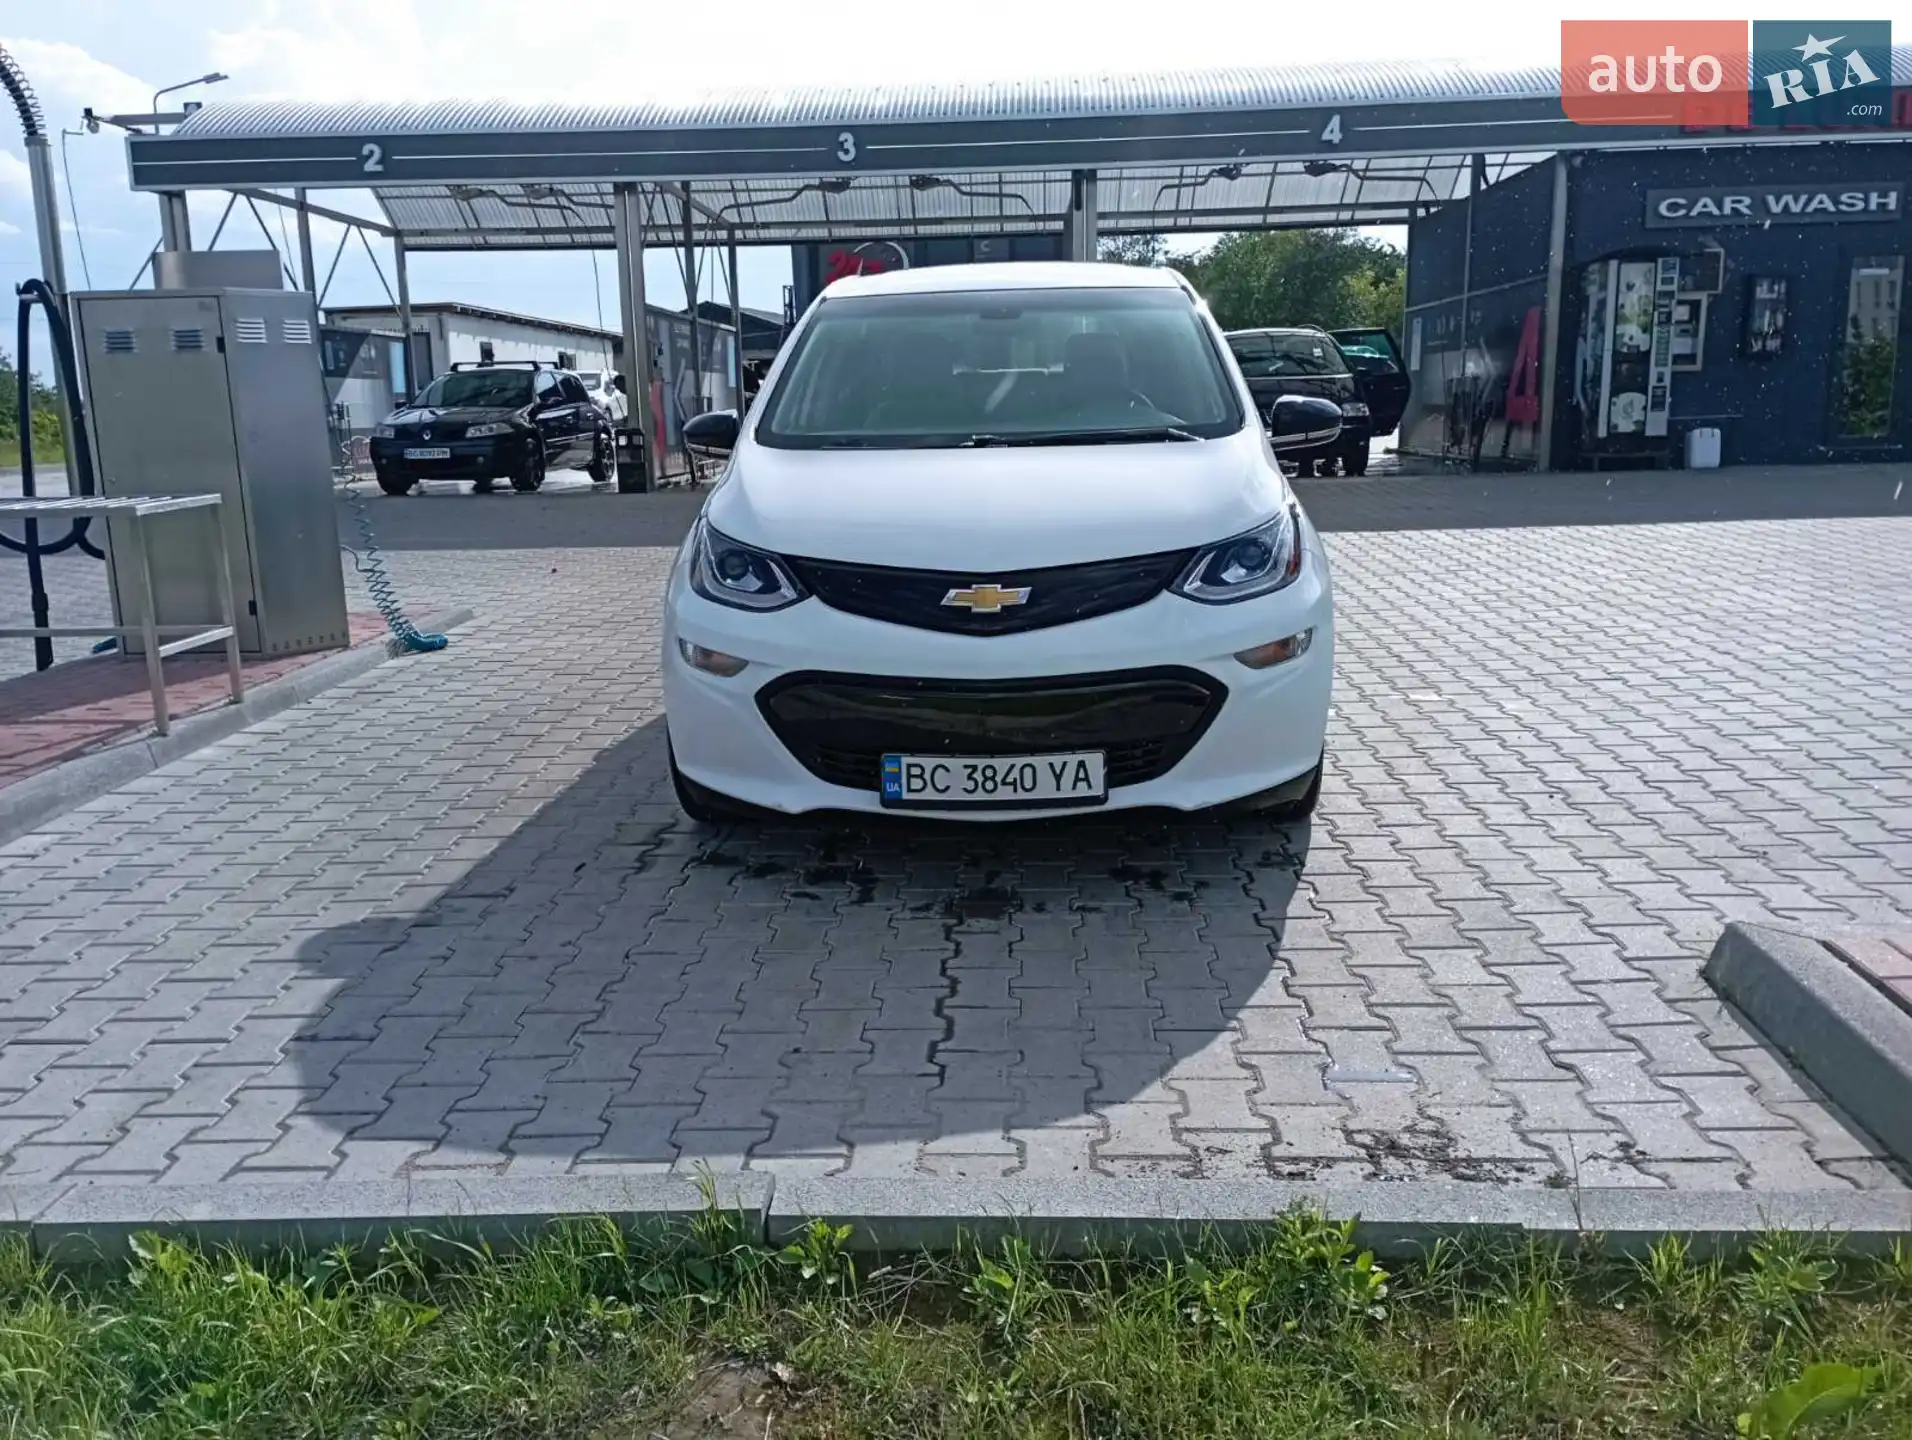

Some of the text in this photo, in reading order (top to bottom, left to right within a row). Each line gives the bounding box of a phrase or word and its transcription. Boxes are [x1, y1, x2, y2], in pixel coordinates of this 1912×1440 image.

[1321, 114, 1343, 144] 4
[362, 142, 384, 172] 2
[837, 131, 857, 162] 3
[1657, 190, 1898, 219] CAR WASH
[885, 782, 900, 793] UA
[905, 759, 1094, 795] BC 3840 YA
